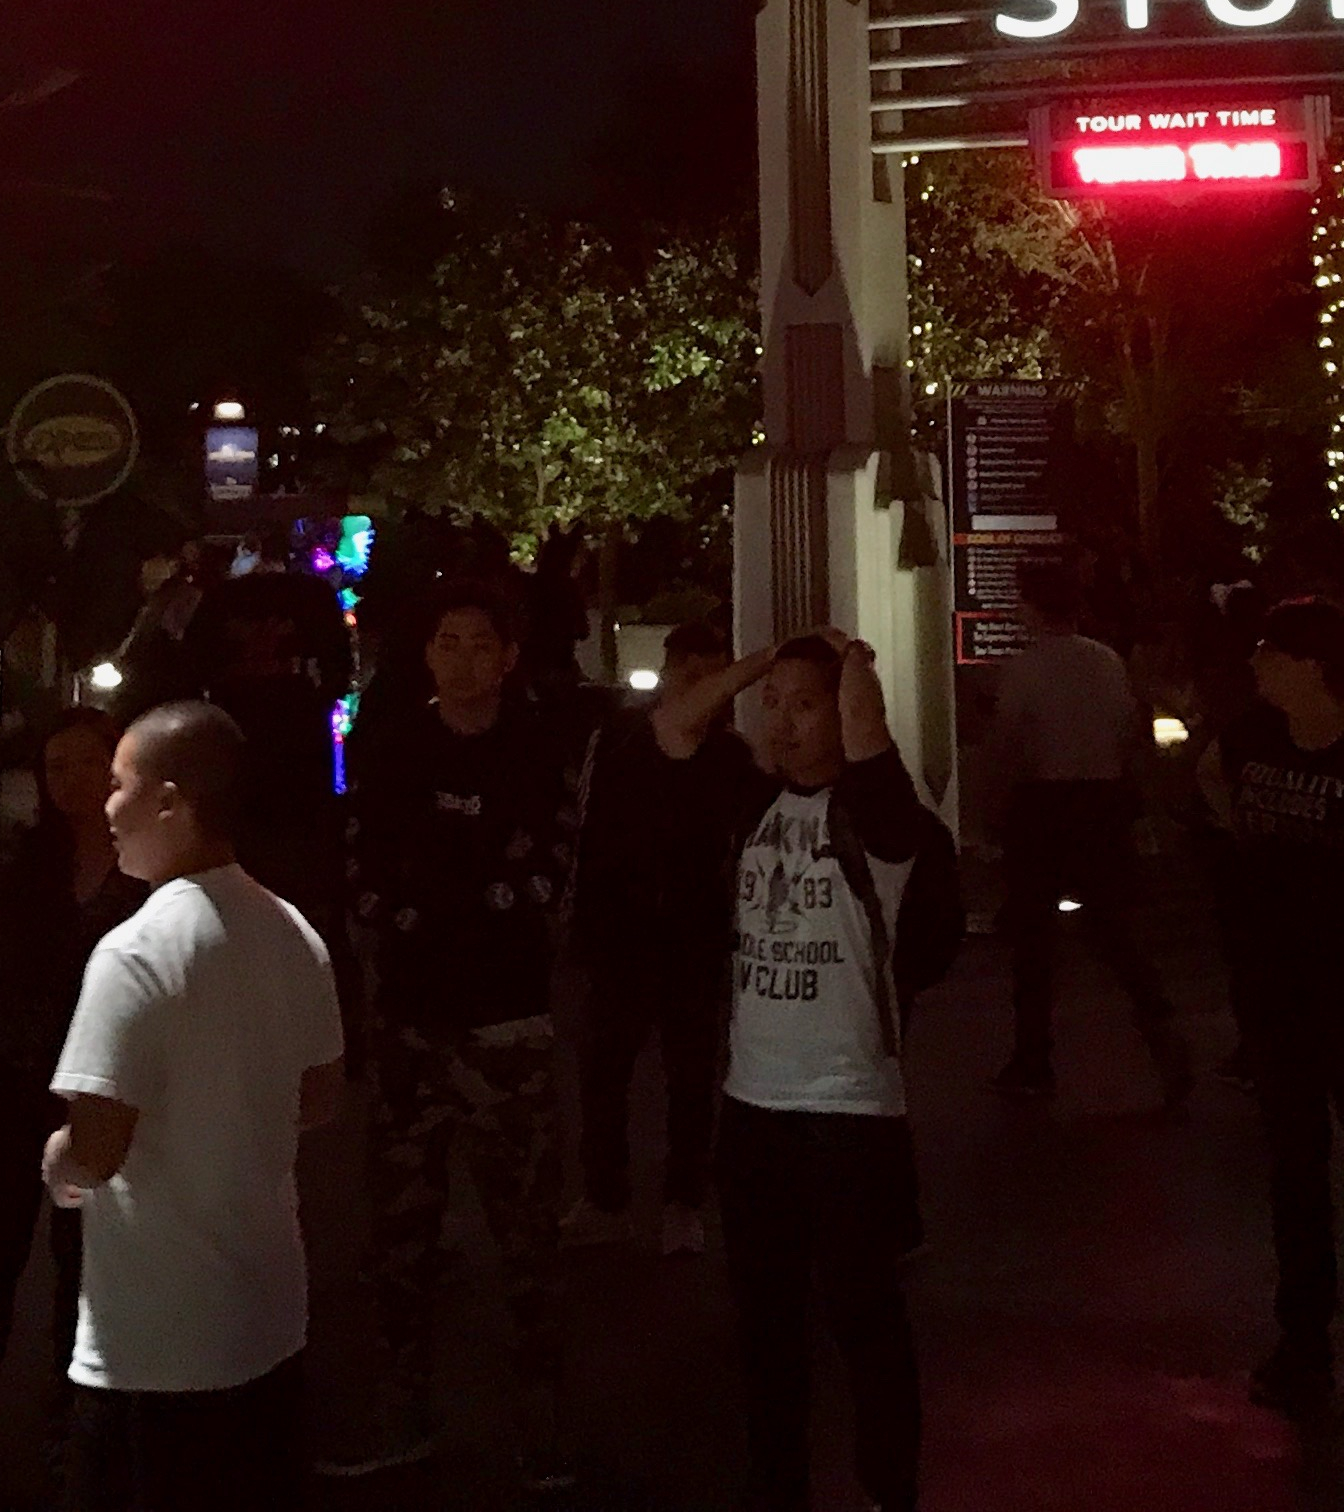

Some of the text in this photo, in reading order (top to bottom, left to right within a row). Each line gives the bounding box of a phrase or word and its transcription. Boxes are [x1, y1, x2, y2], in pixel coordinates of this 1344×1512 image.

[1076, 109, 1276, 133] TOUR WAIT TIME
[803, 877, 832, 909] 83
[771, 940, 845, 965] SCHOOL
[756, 965, 818, 1000] CLUB
